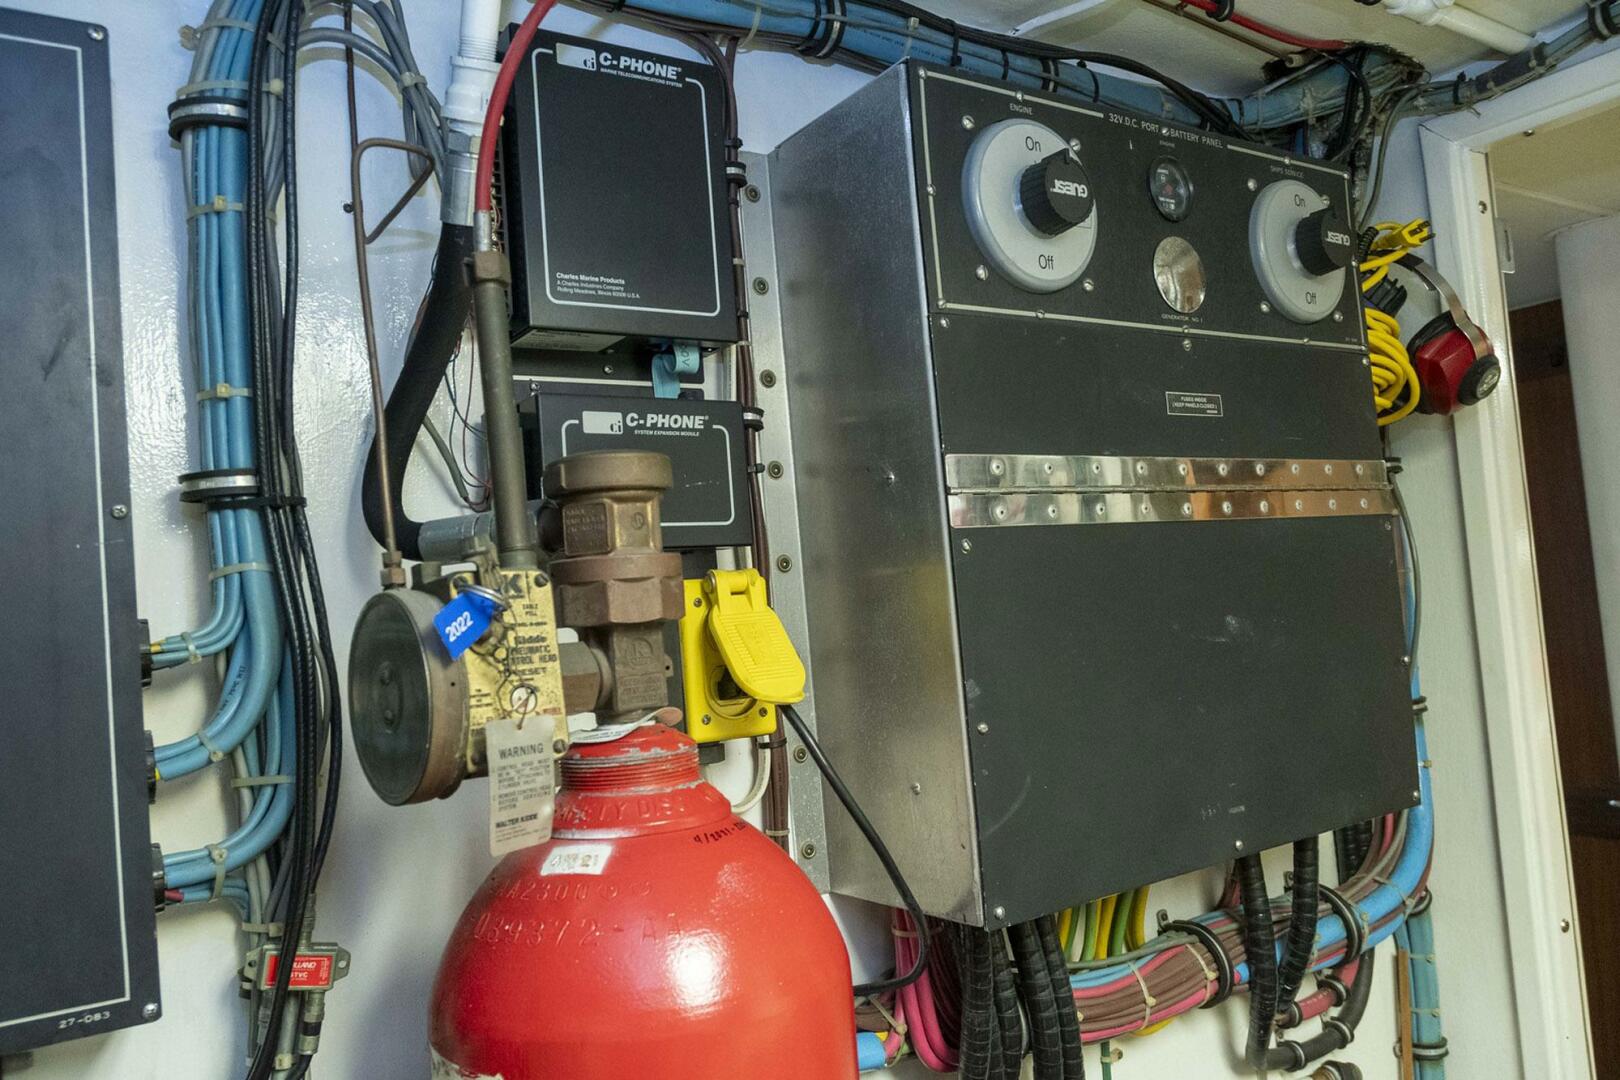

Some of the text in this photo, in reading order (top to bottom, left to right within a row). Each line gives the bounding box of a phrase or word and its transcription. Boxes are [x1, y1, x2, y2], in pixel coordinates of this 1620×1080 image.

[1009, 103, 1033, 115] ENGINE
[1141, 121, 1160, 133] PORT
[1170, 128, 1200, 142] BATTERY
[1202, 136, 1224, 148] PANEL
[1025, 136, 1042, 152] On
[1053, 179, 1089, 198] GUEST
[1294, 193, 1306, 208] On
[1325, 230, 1351, 246] GUEST
[1038, 254, 1054, 270] Off
[556, 271, 626, 285] Charles Marine Products
[1305, 291, 1317, 305] Off
[634, 428, 653, 436] SYSTEM
[653, 429, 681, 437] EXPANSION
[445, 611, 474, 643] 2022
[498, 742, 544, 760] WARNING
